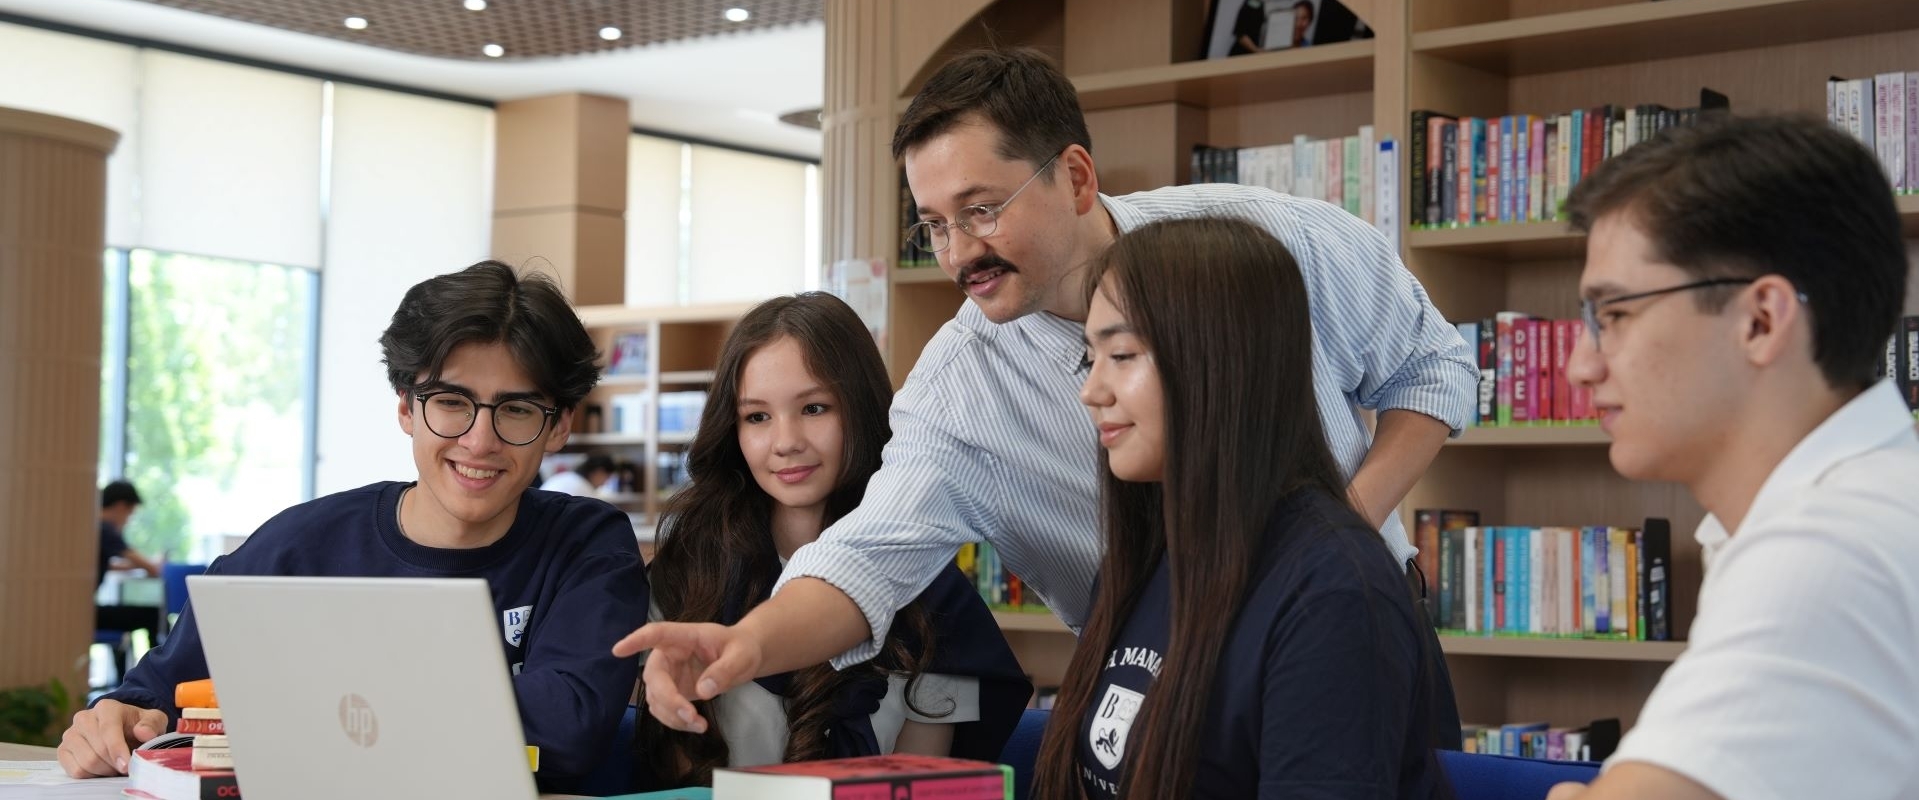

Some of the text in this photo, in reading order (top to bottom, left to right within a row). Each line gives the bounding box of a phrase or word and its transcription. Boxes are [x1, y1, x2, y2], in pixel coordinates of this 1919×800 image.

[1514, 329, 1526, 400] DUNE
[507, 611, 521, 627] B
[345, 692, 374, 748] hp
[1101, 693, 1119, 719] B
[1083, 766, 1119, 795] NIVE
